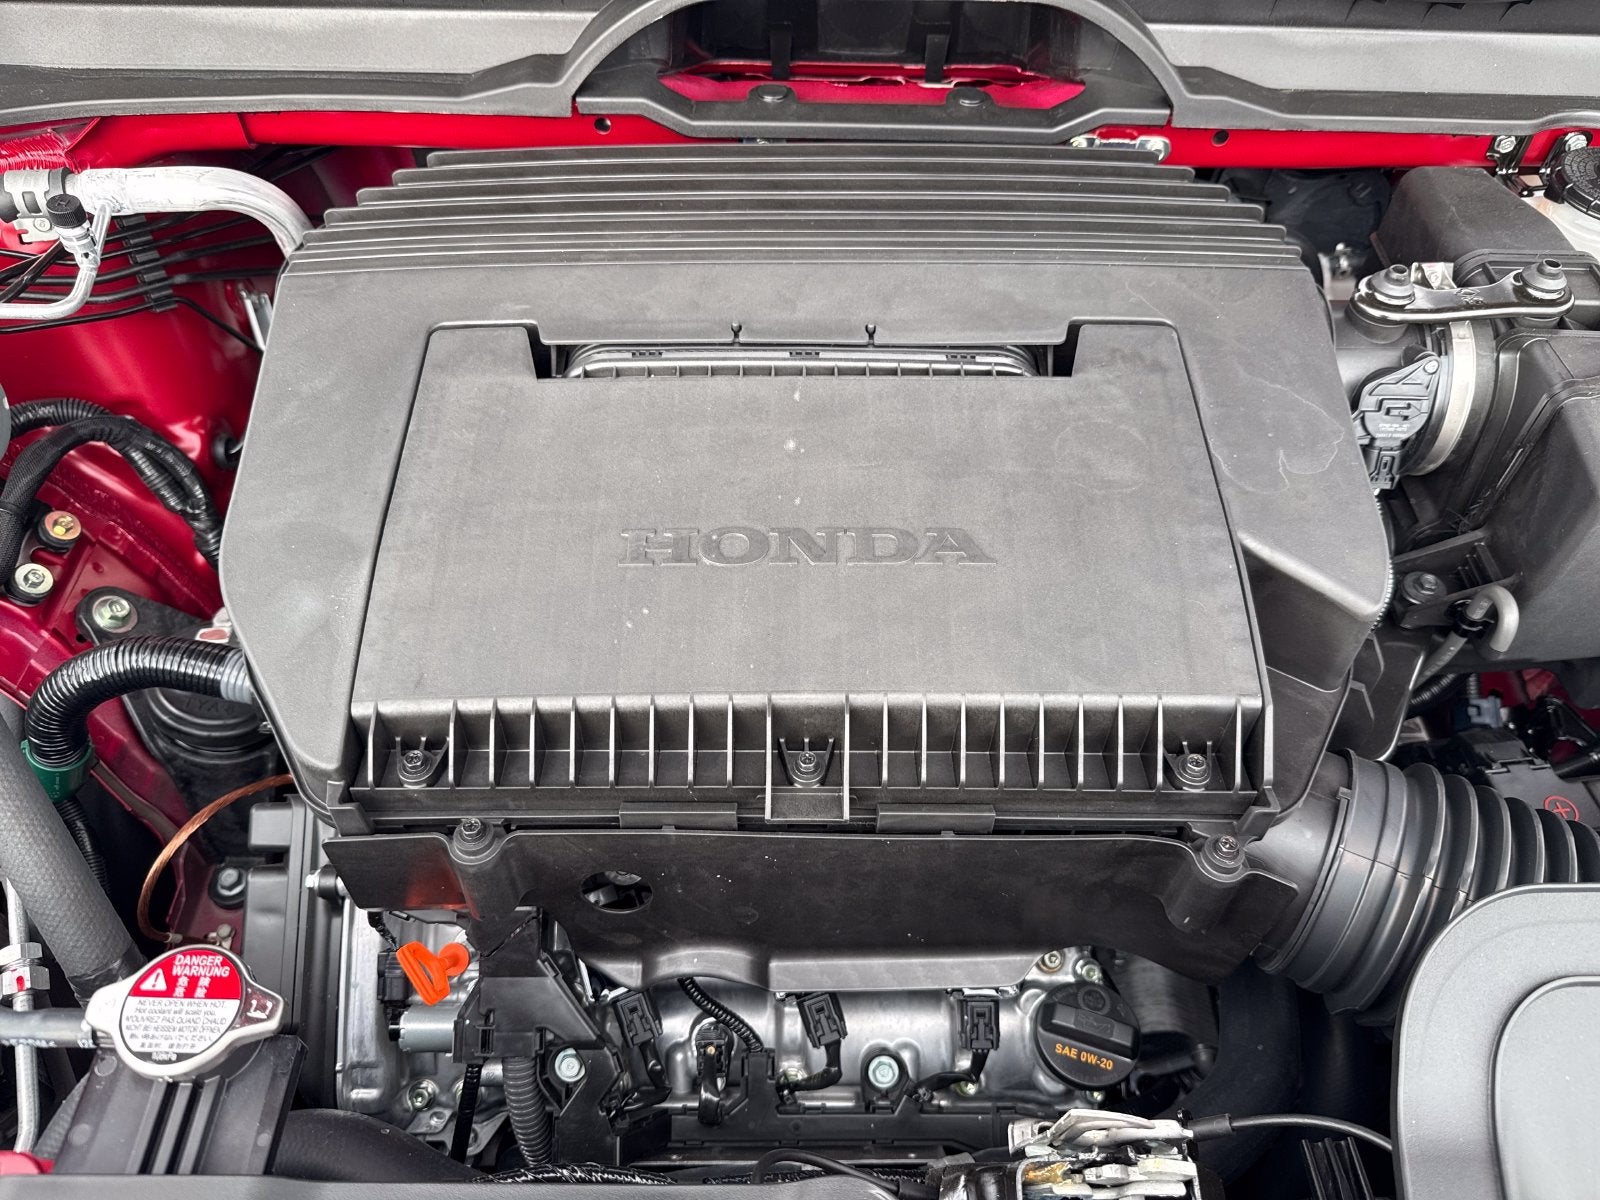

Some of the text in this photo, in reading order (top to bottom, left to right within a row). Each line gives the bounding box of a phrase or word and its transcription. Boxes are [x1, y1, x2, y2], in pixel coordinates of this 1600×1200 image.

[618, 527, 996, 566] HONDA
[175, 954, 223, 966] DANGER
[172, 965, 230, 977] WARNUNG
[187, 1000, 208, 1008] WHEN
[1055, 1043, 1113, 1070] SAE 0W-20
